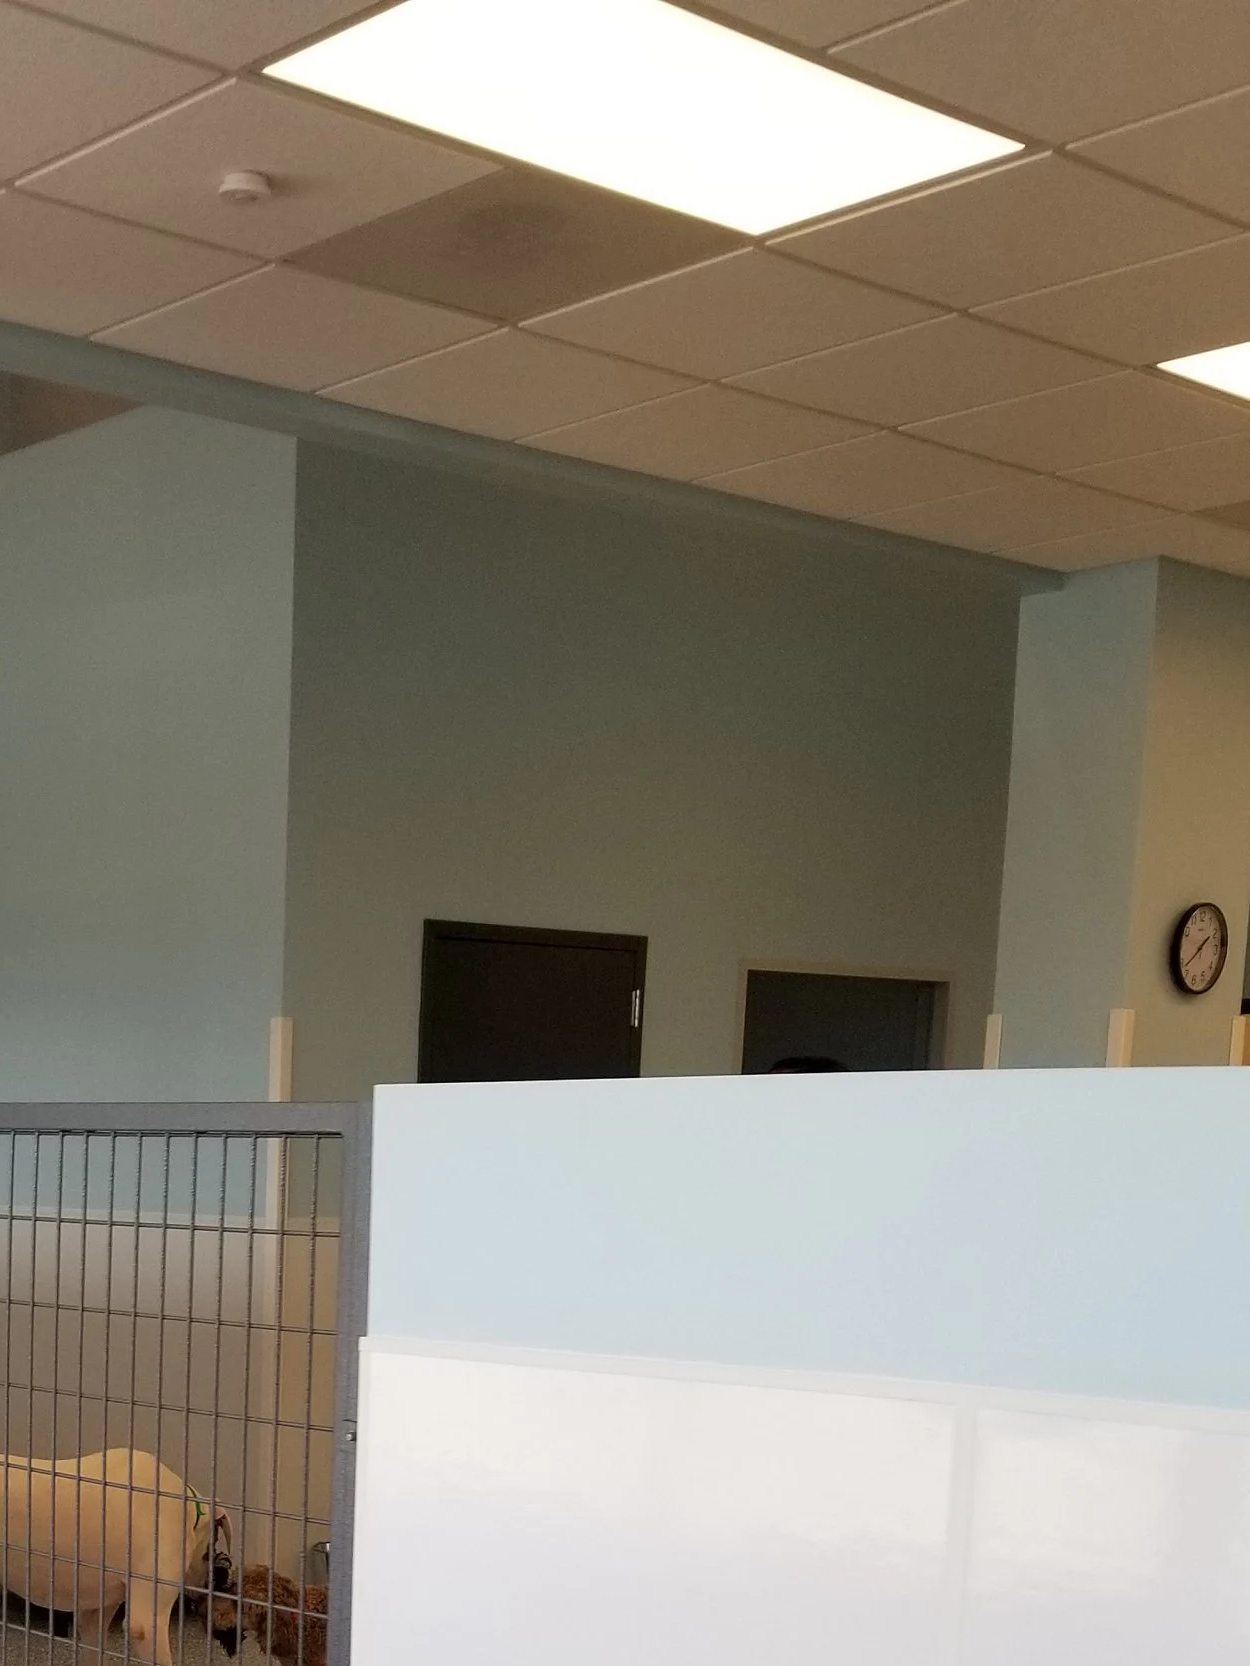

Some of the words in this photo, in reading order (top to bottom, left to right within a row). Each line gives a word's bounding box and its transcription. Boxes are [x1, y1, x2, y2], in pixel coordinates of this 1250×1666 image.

[1191, 915, 1197, 926] 11
[1199, 911, 1206, 922] 12
[1212, 928, 1218, 939] 2
[1214, 944, 1218, 956] 3
[1191, 974, 1197, 986] 6
[1200, 970, 1206, 982] 5
